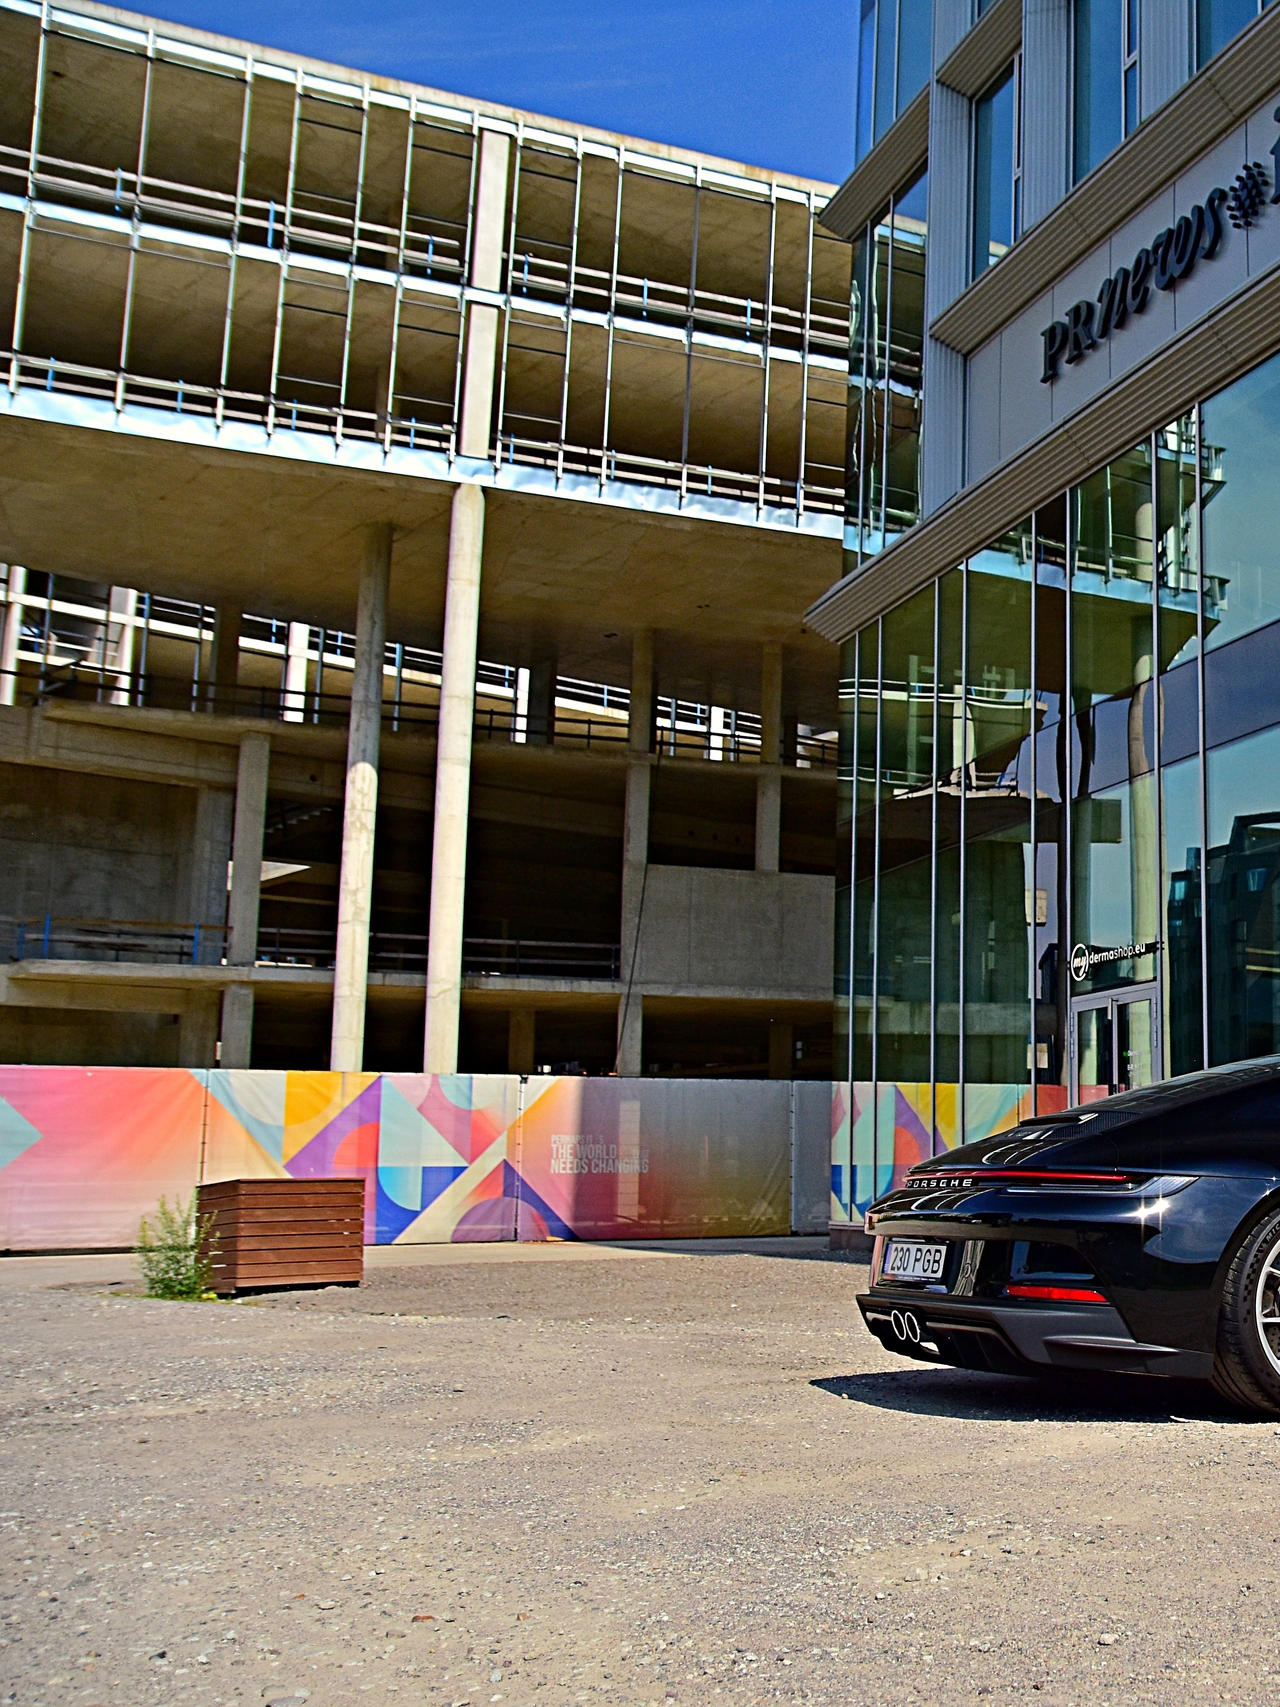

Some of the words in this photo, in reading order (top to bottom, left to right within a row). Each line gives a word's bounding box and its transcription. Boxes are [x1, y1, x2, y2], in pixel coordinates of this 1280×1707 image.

[552, 1144, 574, 1159] THE
[576, 1144, 617, 1159] WORLD
[551, 1159, 589, 1174] NEEDS
[591, 1159, 650, 1174] CHANGING
[906, 1178, 973, 1188] PORSCHE
[890, 1246, 911, 1272] 230
[911, 1247, 942, 1274] PGB
